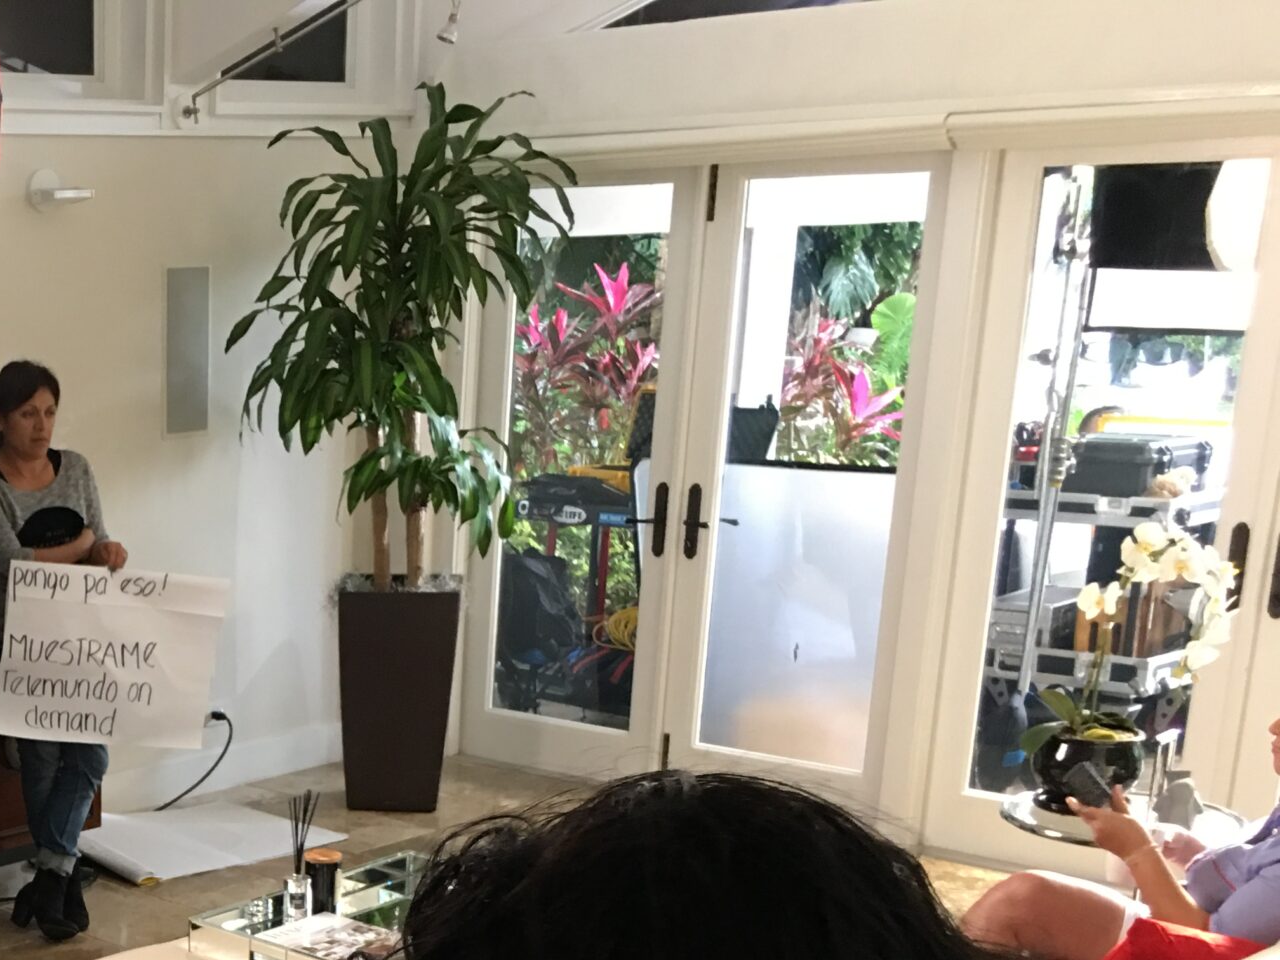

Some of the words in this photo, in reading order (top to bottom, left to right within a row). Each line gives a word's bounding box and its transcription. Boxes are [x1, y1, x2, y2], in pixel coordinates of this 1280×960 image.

[12, 566, 70, 602] pongo
[120, 573, 169, 598] eso!
[127, 681, 153, 706] on
[24, 705, 117, 737] demand
